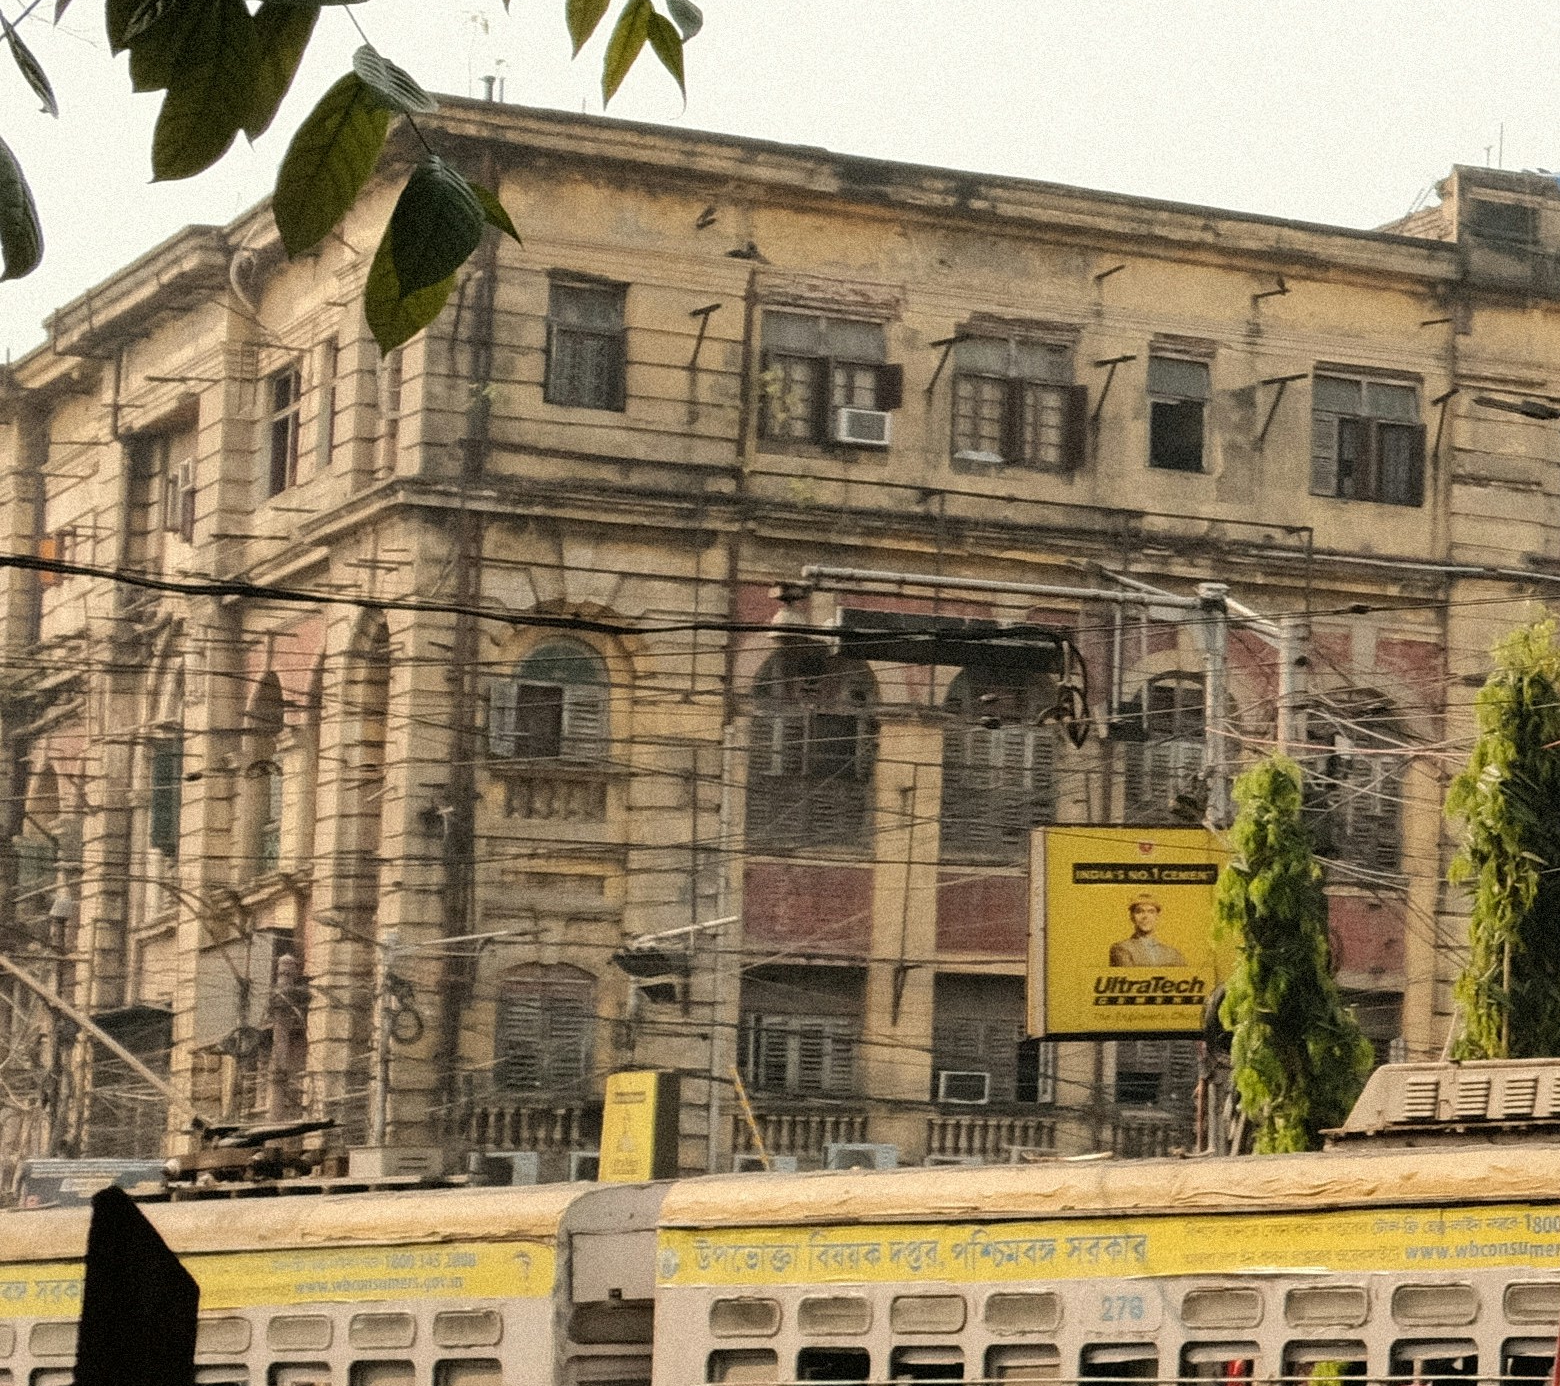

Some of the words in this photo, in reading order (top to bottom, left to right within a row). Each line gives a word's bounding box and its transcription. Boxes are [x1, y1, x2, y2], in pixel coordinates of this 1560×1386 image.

[1076, 867, 1124, 879] INDIA'S
[1128, 865, 1159, 879] NO.1
[1094, 974, 1205, 994] UltraTech
[692, 1238, 800, 1274] উপভোক্তা
[806, 1230, 883, 1273] বিষয়ক
[950, 1227, 1057, 1272] পশ্চিমবঙ্গ
[1065, 1232, 1149, 1268] সরকার
